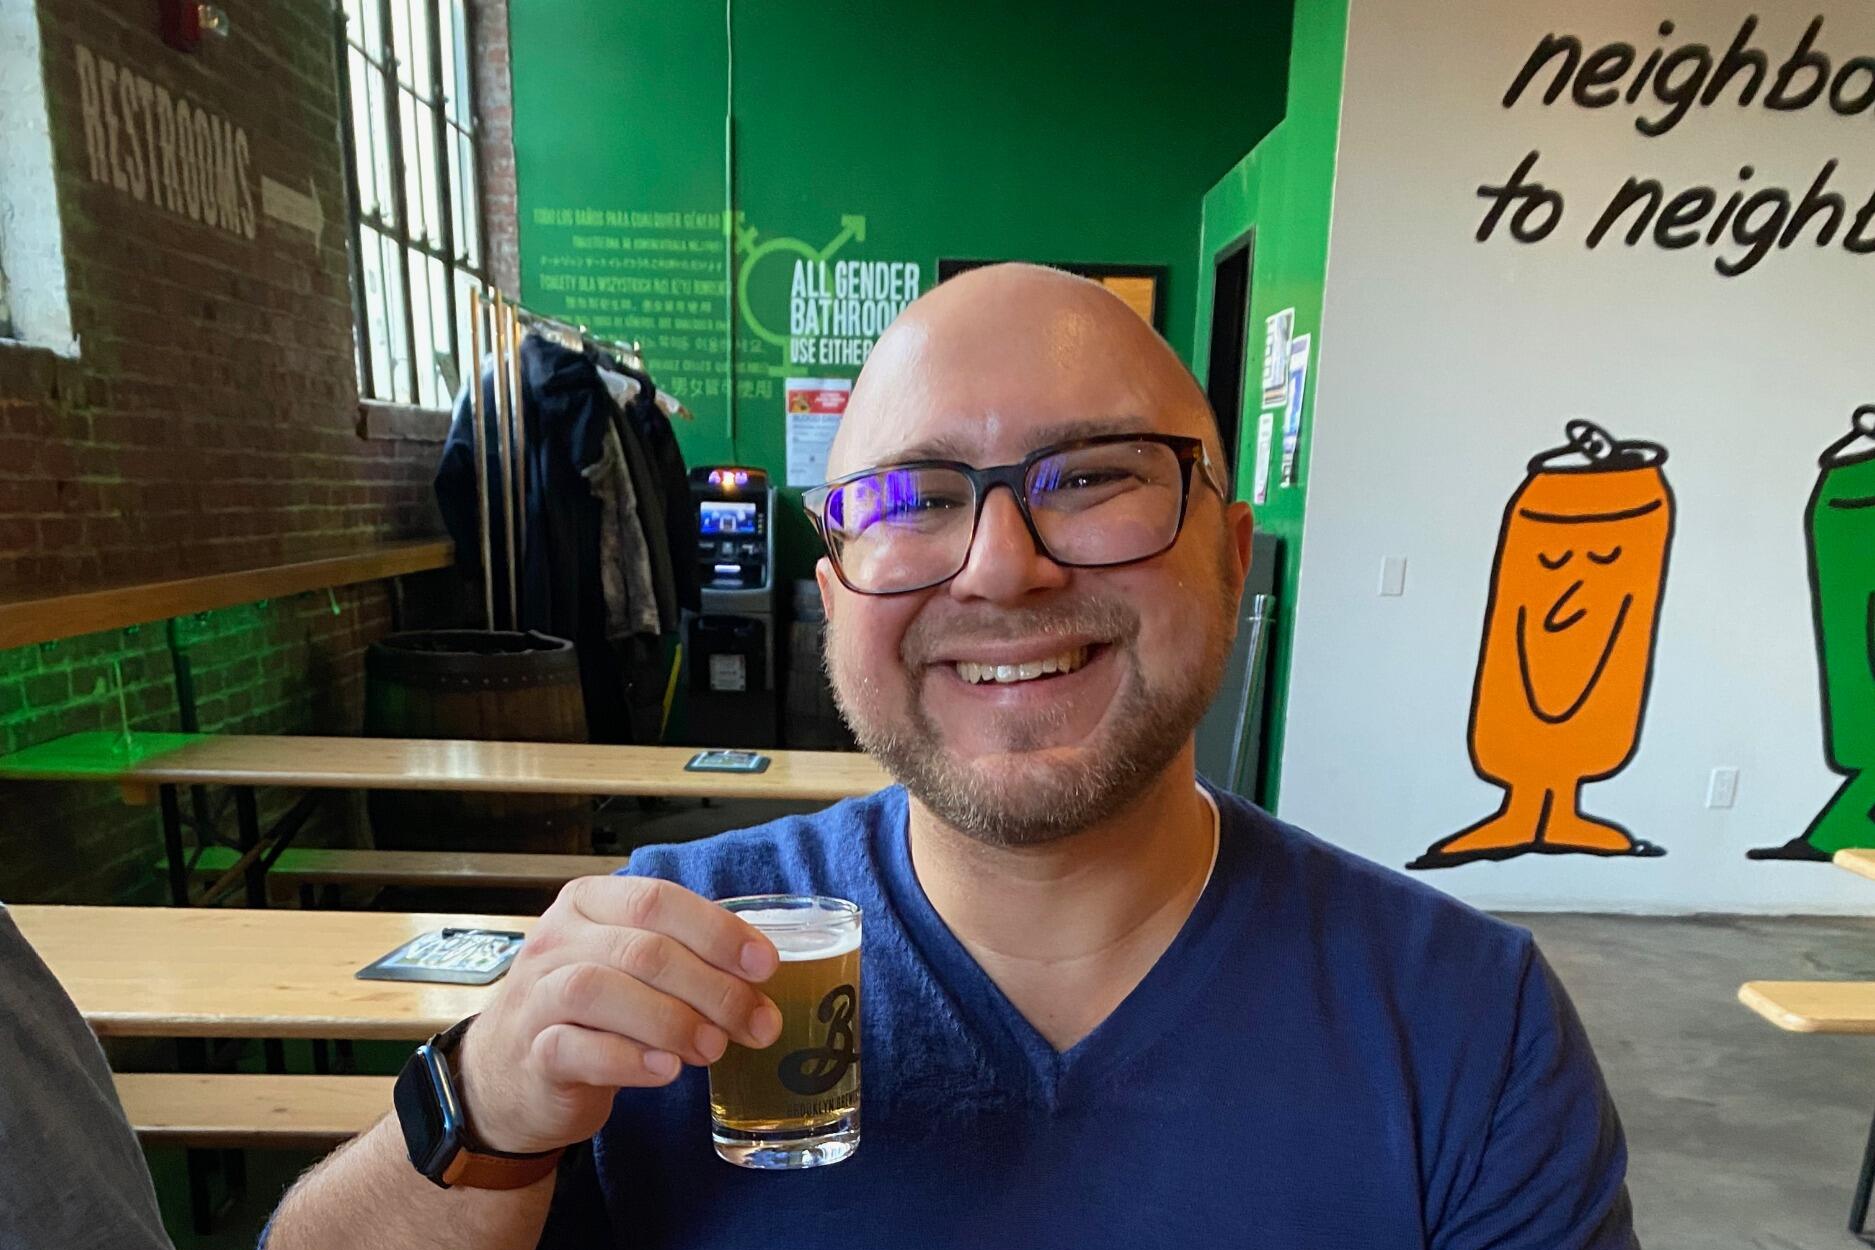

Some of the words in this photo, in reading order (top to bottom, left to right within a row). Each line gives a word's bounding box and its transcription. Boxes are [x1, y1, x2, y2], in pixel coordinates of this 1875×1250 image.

[1502, 14, 1875, 137] neighbo
[76, 44, 256, 239] RESTROOMS
[1476, 149, 1564, 243] to
[790, 259, 831, 298] ALL
[835, 260, 920, 300] GENDER
[790, 337, 816, 363] USE
